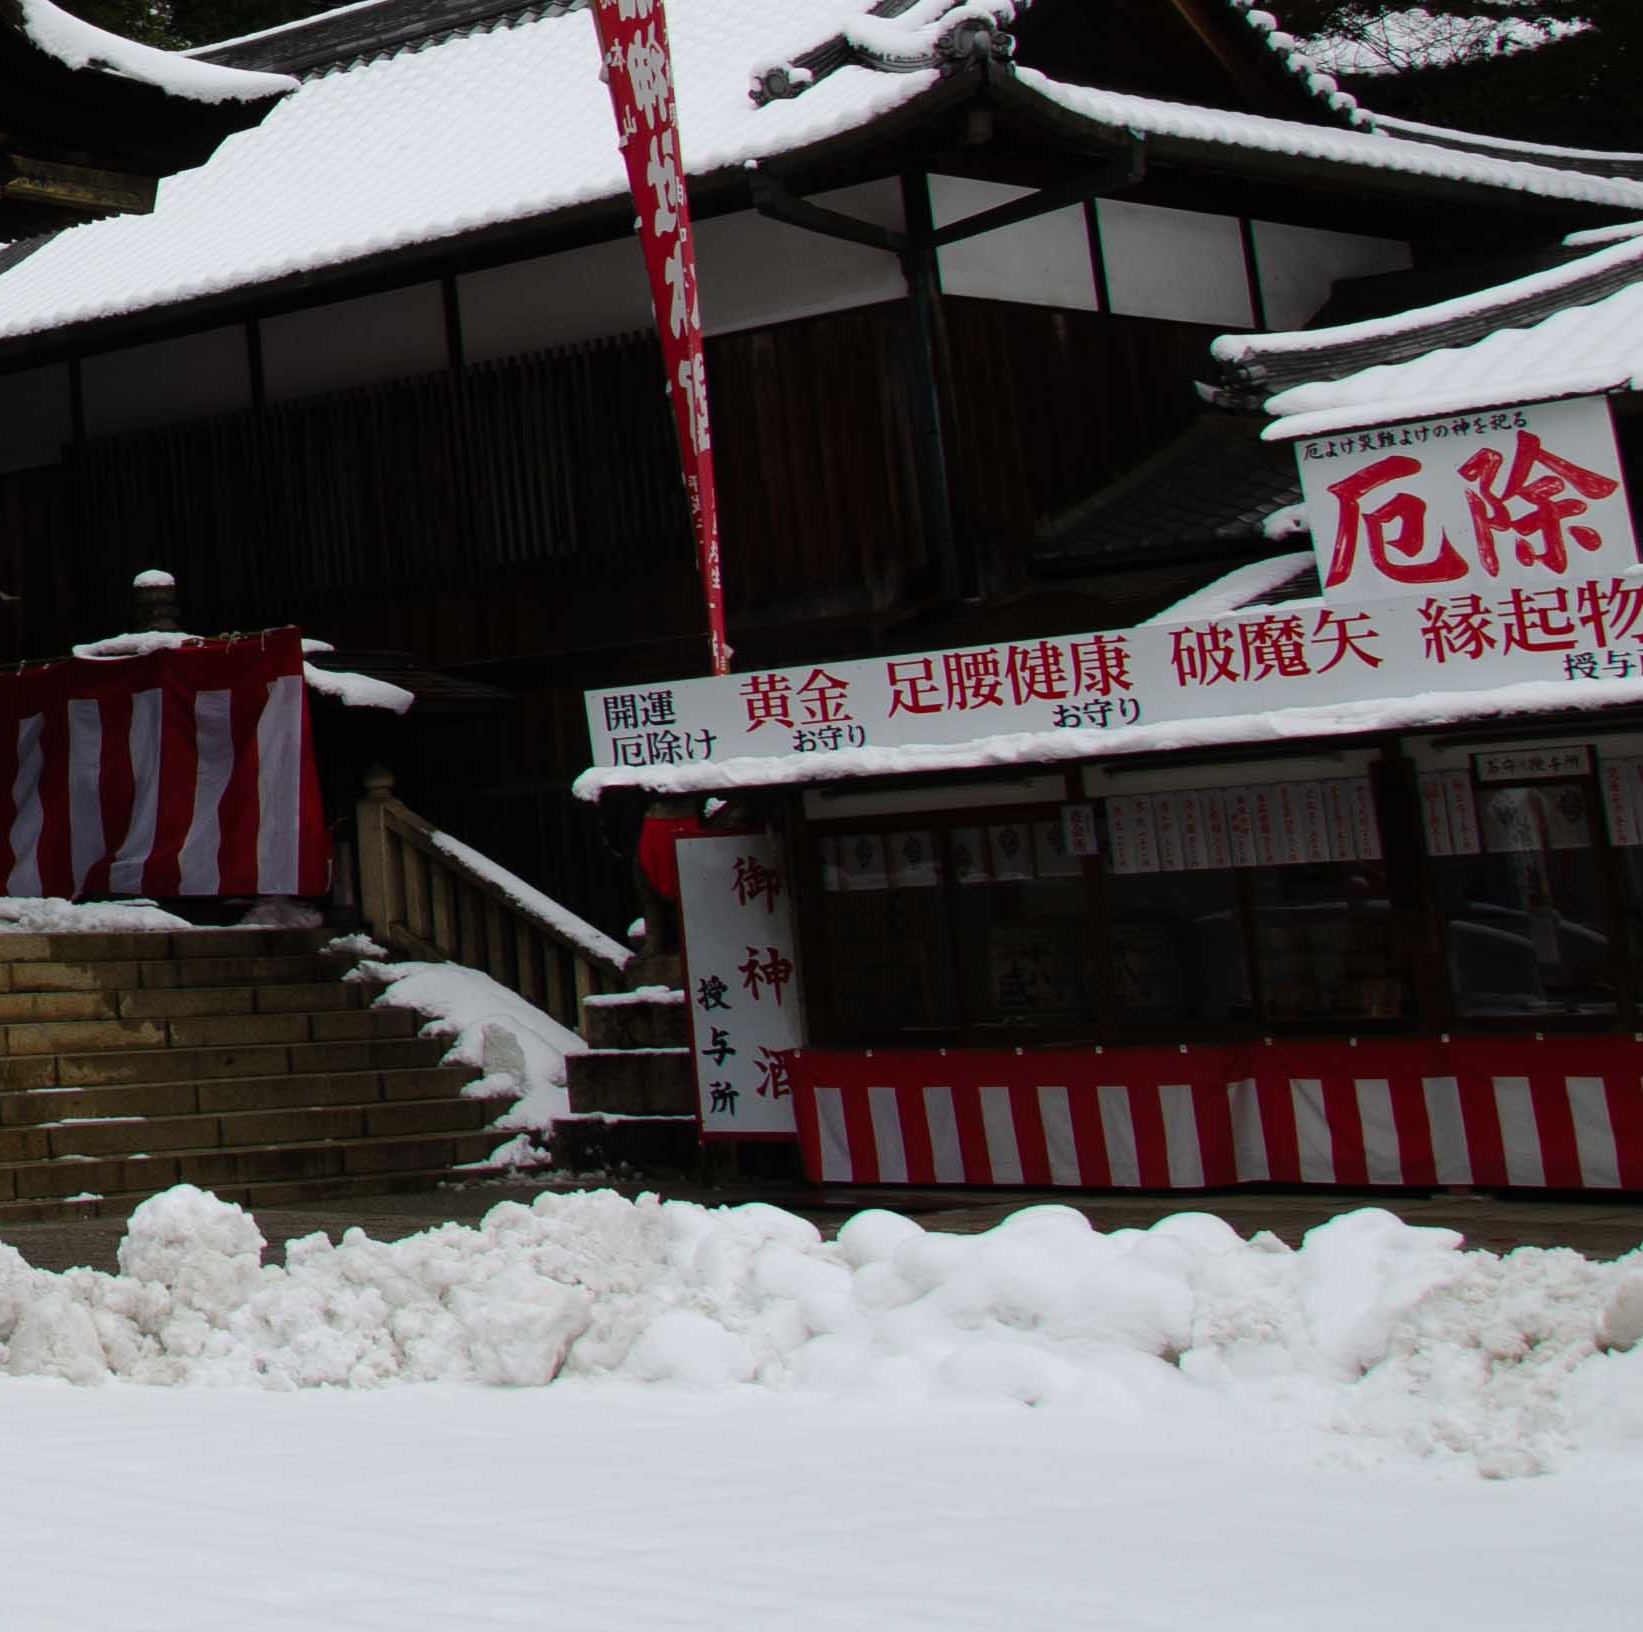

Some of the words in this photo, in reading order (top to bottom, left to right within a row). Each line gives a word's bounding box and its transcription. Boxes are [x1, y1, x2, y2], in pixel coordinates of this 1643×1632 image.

[1323, 430, 1619, 588] 厄除
[1168, 608, 1383, 688] 破魔矢
[1417, 578, 1643, 665] 縁起物
[738, 668, 853, 733] 黄金
[887, 635, 1133, 718] 足腰健康
[1563, 649, 1643, 681] 授与
[603, 690, 676, 732] 開運
[792, 724, 867, 754] お守り
[1052, 696, 1141, 729] お守り
[610, 728, 718, 768] 厄除け
[731, 856, 794, 1100] 御神酒
[697, 975, 739, 1117] 授与所
